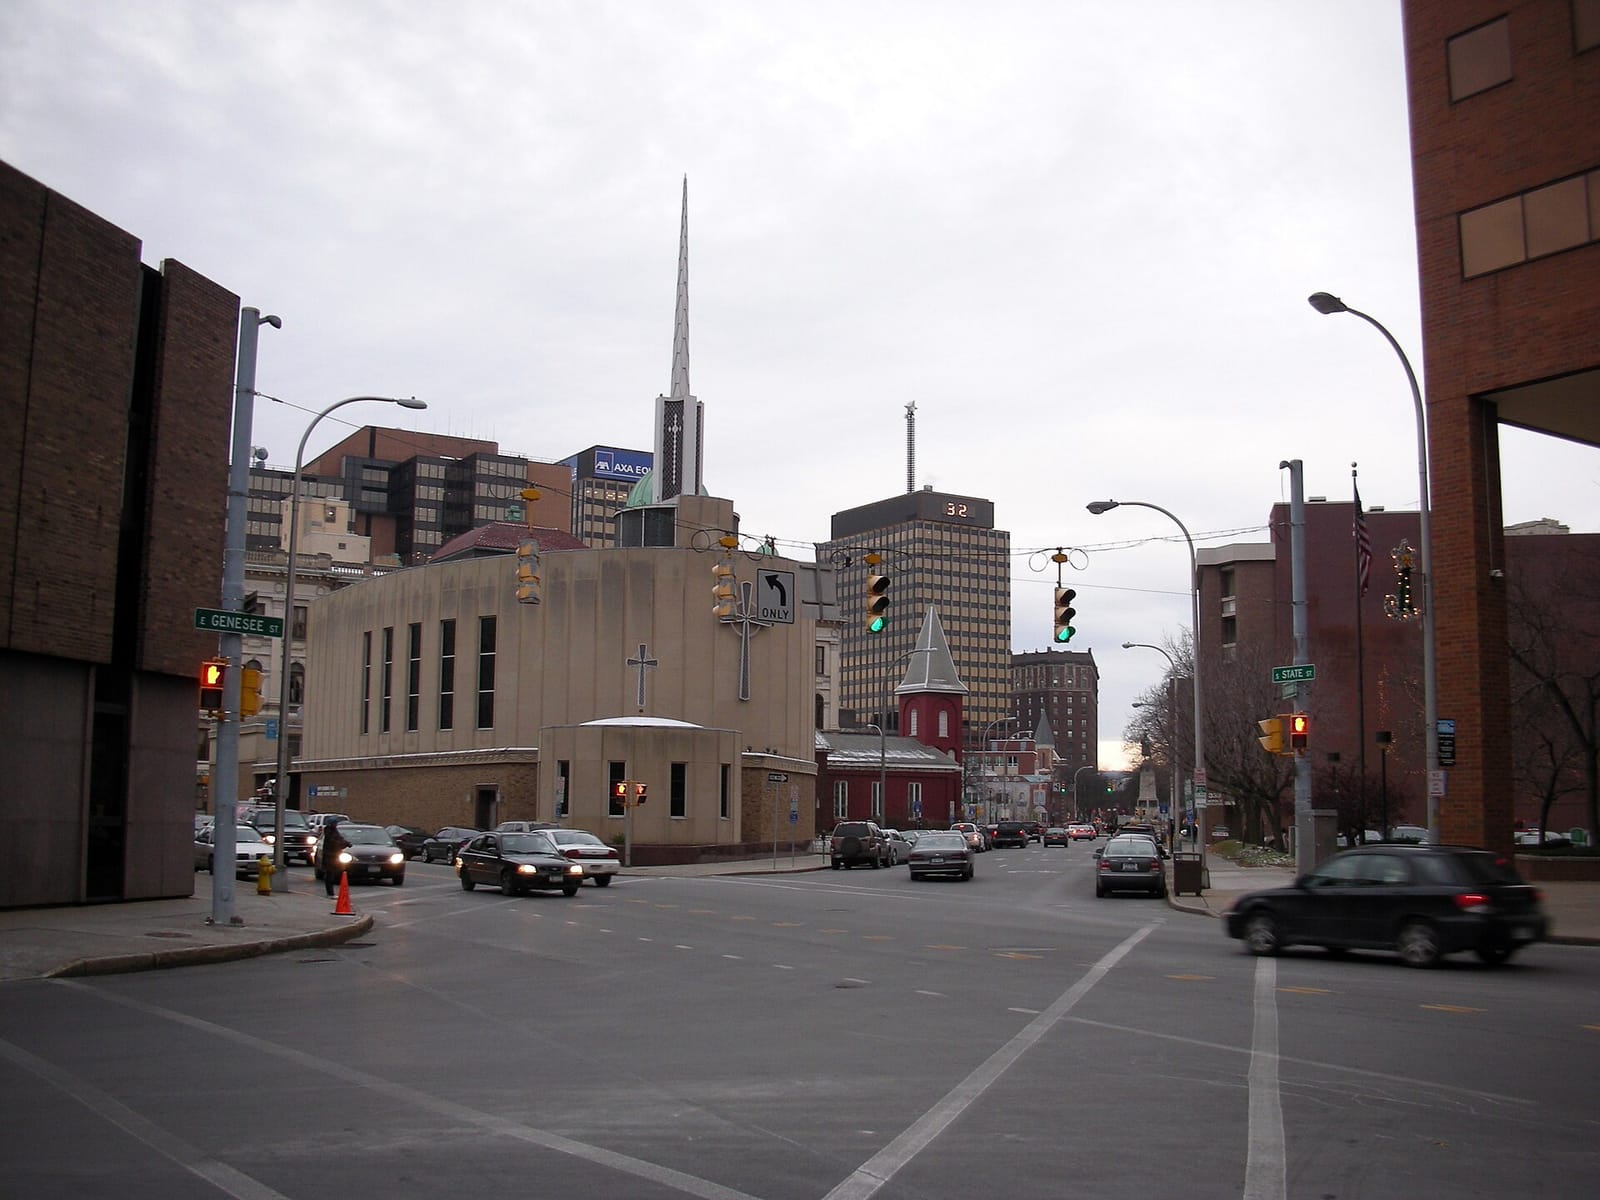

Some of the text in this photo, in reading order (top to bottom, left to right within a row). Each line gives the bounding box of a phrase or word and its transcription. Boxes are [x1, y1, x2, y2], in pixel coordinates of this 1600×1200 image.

[614, 463, 634, 473] AXA
[947, 502, 967, 517] 32
[762, 607, 789, 620] ONLY
[200, 614, 279, 633] E GENESEE ST
[1281, 669, 1304, 679] STATE
